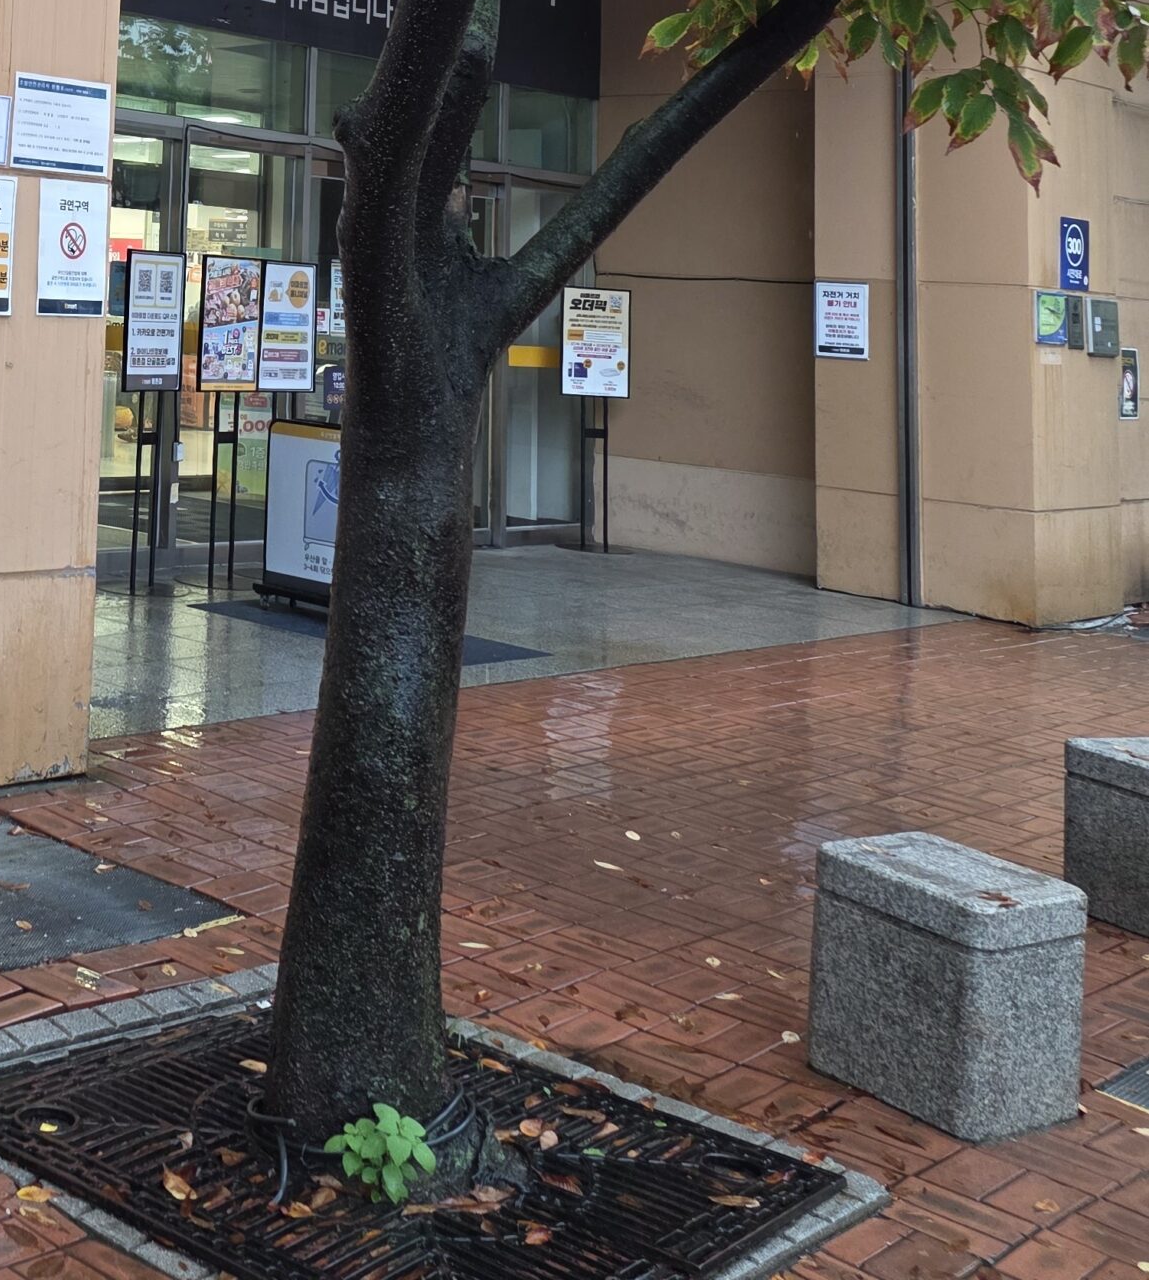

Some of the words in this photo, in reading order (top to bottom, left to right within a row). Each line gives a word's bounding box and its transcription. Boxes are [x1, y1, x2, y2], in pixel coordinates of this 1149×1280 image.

[59, 198, 89, 213] 금연구역
[1067, 236, 1082, 255] 300
[822, 290, 844, 299] 자전거
[845, 291, 860, 300] 거치
[569, 298, 608, 312] 오더픽
